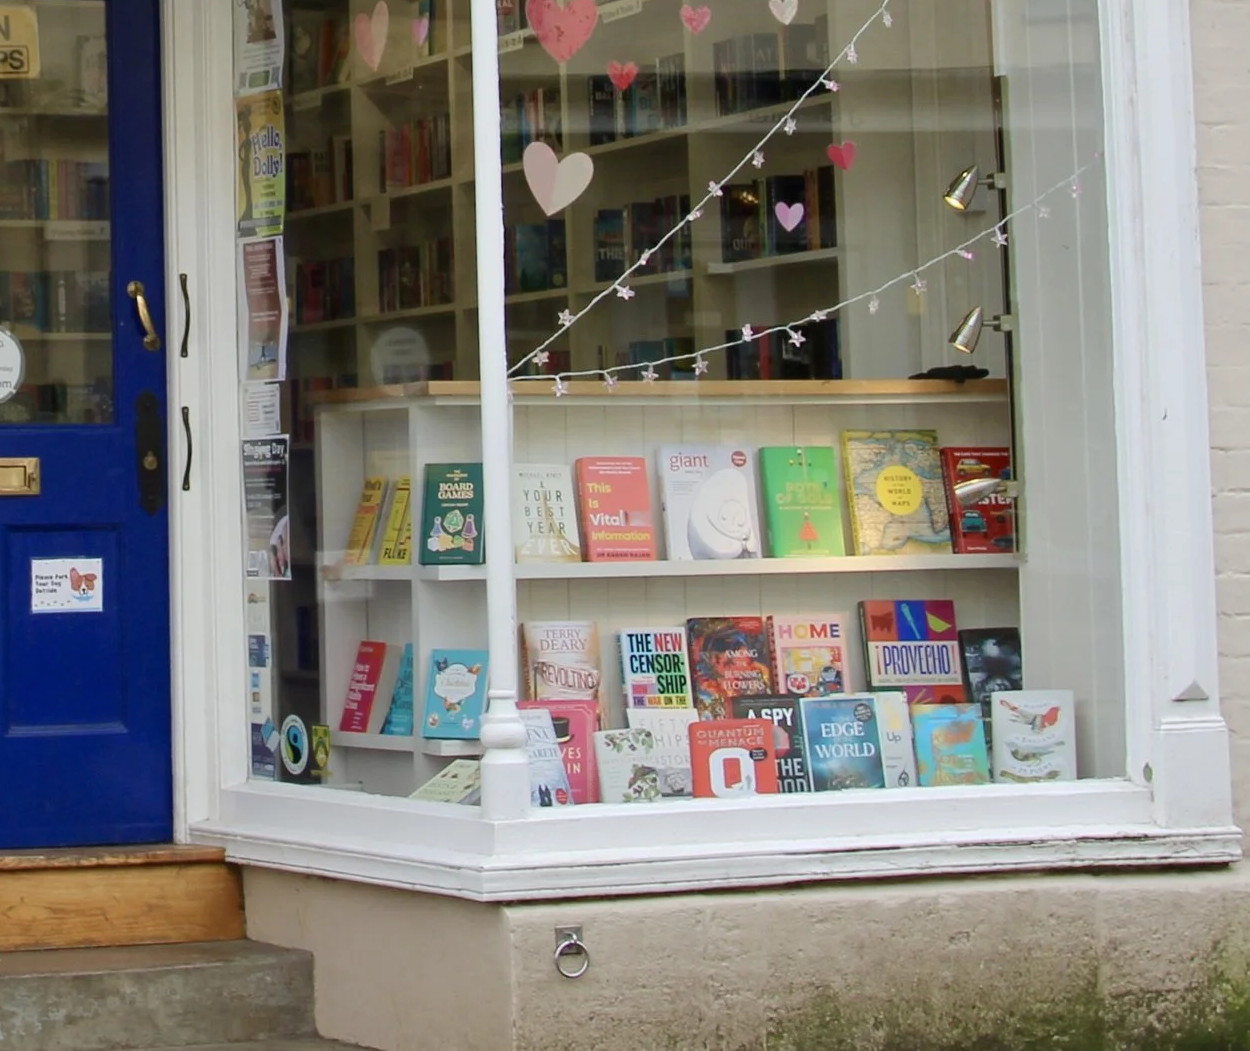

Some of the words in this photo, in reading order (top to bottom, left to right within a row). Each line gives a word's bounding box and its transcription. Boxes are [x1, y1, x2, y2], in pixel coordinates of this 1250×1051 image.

[252, 125, 283, 154] Hello,
[253, 152, 284, 178] Dolly!
[669, 452, 710, 472] giant
[439, 482, 474, 491] BOARD
[586, 482, 612, 495] This
[888, 488, 912, 496] WORLD
[438, 490, 474, 500] GAMES
[523, 489, 563, 503] YOUR
[588, 498, 600, 510] Is
[524, 505, 565, 518] BEST
[590, 509, 626, 528] Vital
[527, 521, 567, 535] YEAR
[591, 530, 651, 543] Information
[543, 629, 582, 640] TERRY
[778, 622, 841, 641] HOME
[540, 638, 588, 651] DEARY
[626, 633, 652, 653] THE
[654, 633, 683, 653] NEW
[724, 649, 759, 659] AMONG
[629, 653, 686, 675] CENSOR-
[541, 661, 597, 690] REVOLTING
[724, 669, 762, 680] BURNING
[657, 674, 688, 695] SHIP
[723, 679, 766, 691] FLOWERS
[633, 696, 646, 707] THE
[676, 696, 687, 706] THE
[761, 707, 794, 727] SPY
[696, 728, 764, 740] QUANTUM
[820, 721, 865, 738] EDGE
[654, 734, 690, 748] HIPS
[708, 736, 764, 748] MENACE
[886, 732, 901, 744] Up
[814, 741, 876, 759] WORLD
[567, 762, 581, 775] IN
